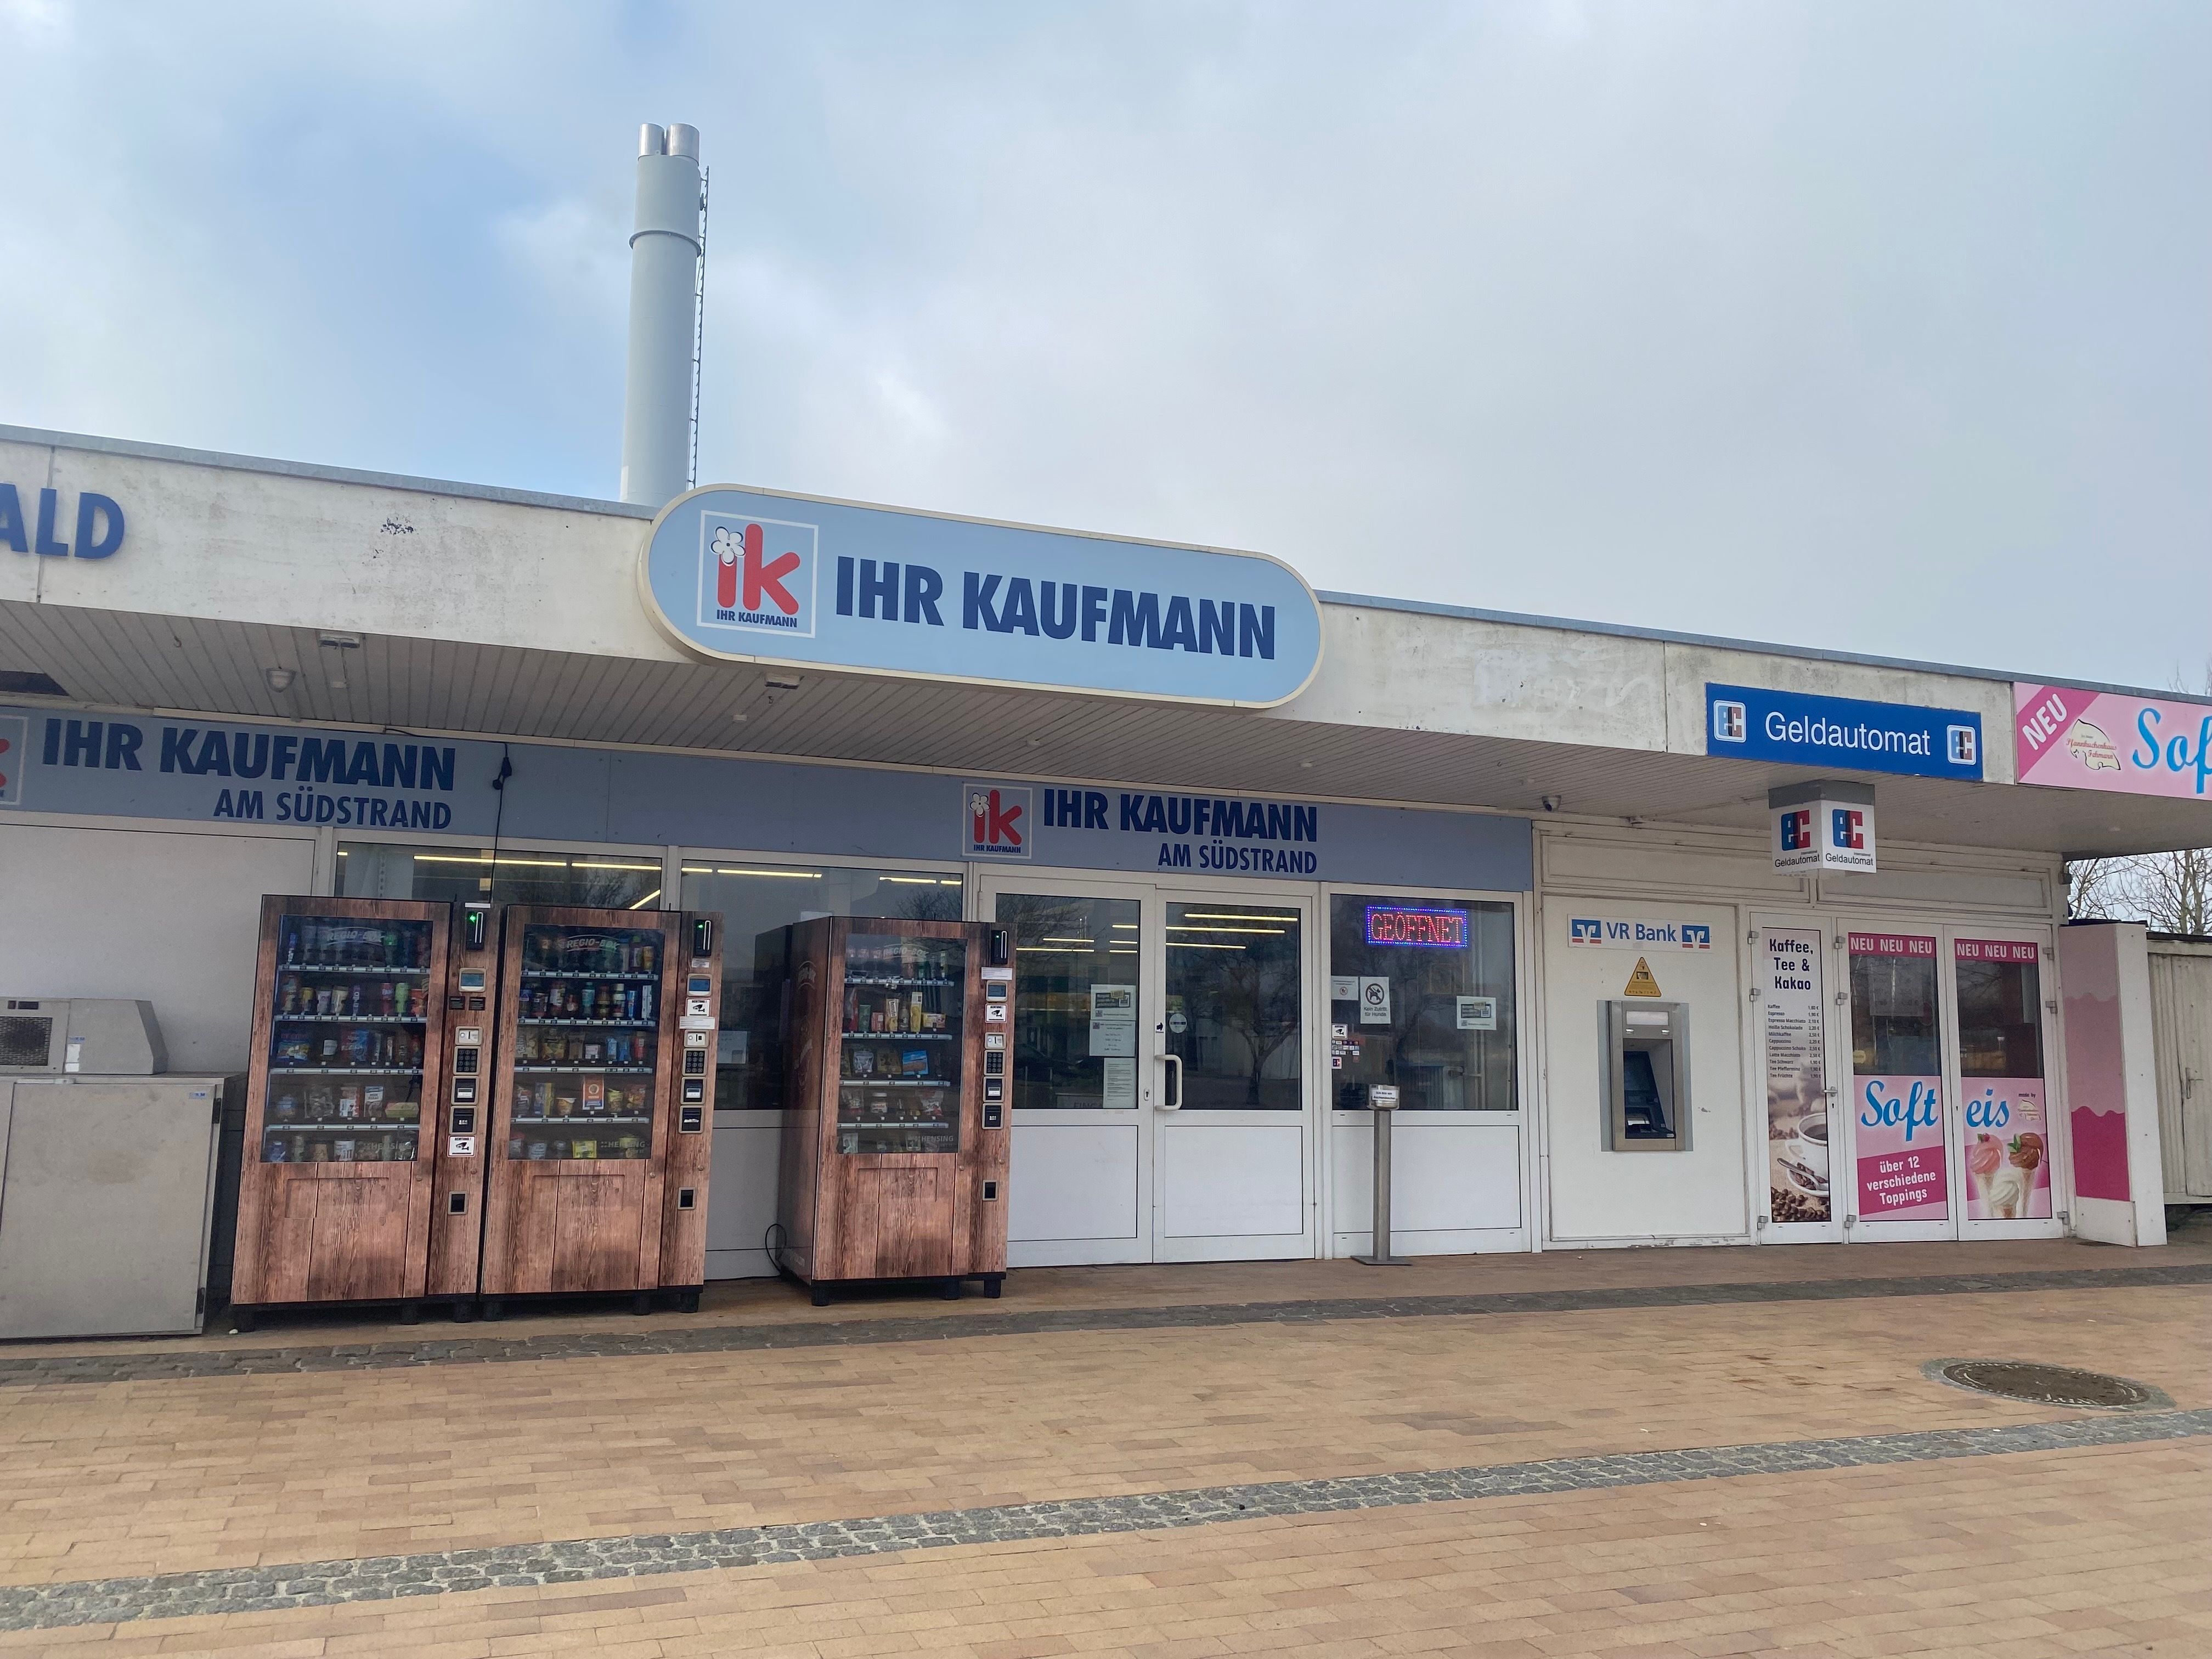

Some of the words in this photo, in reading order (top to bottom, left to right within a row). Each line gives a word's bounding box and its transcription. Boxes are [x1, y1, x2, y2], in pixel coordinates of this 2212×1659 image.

[836, 555, 945, 627] IHR
[963, 571, 1274, 660] KAUFMANN
[716, 610, 736, 622] IHR
[738, 612, 798, 628] KAUFMANN
[2022, 693, 2067, 751] NEU
[1765, 711, 1931, 756] Geldautomat
[42, 718, 143, 771] IHR
[160, 727, 456, 791] KAUFMANN
[214, 789, 264, 820] AM
[276, 786, 452, 830] SÜDSTRAND
[1043, 788, 1109, 830] IHR
[1120, 794, 1317, 842] KAUFMANN
[986, 845, 1022, 854] KAUFMANN
[1158, 843, 1192, 867] AM
[1199, 840, 1317, 874] SÜDSTRAND
[1775, 854, 1820, 867] Geldautomat
[1825, 853, 1874, 866] Geldautomat
[1371, 911, 1464, 944] GEÖFFNET
[1606, 922, 1630, 940] VR
[1635, 924, 1677, 942] Bank
[1769, 938, 1813, 955] Kaffee,
[1850, 938, 1874, 951] NEU
[1880, 939, 1903, 952] NEU
[1909, 940, 1932, 954] NEU
[1957, 943, 1979, 957] NEU
[1985, 945, 2007, 958] NEU
[2013, 946, 2034, 960] NEU
[1774, 957, 1795, 970] Tee
[1802, 958, 1810, 971] &
[1775, 976, 1811, 990] Kakao
[1861, 1080, 1938, 1142] Soft
[1966, 1088, 2010, 1128] eis
[1880, 1161, 1903, 1173] über
[1908, 1156, 1920, 1169] 12
[1866, 1171, 1936, 1191] verschiedene
[1880, 1188, 1927, 1206] Toppings
